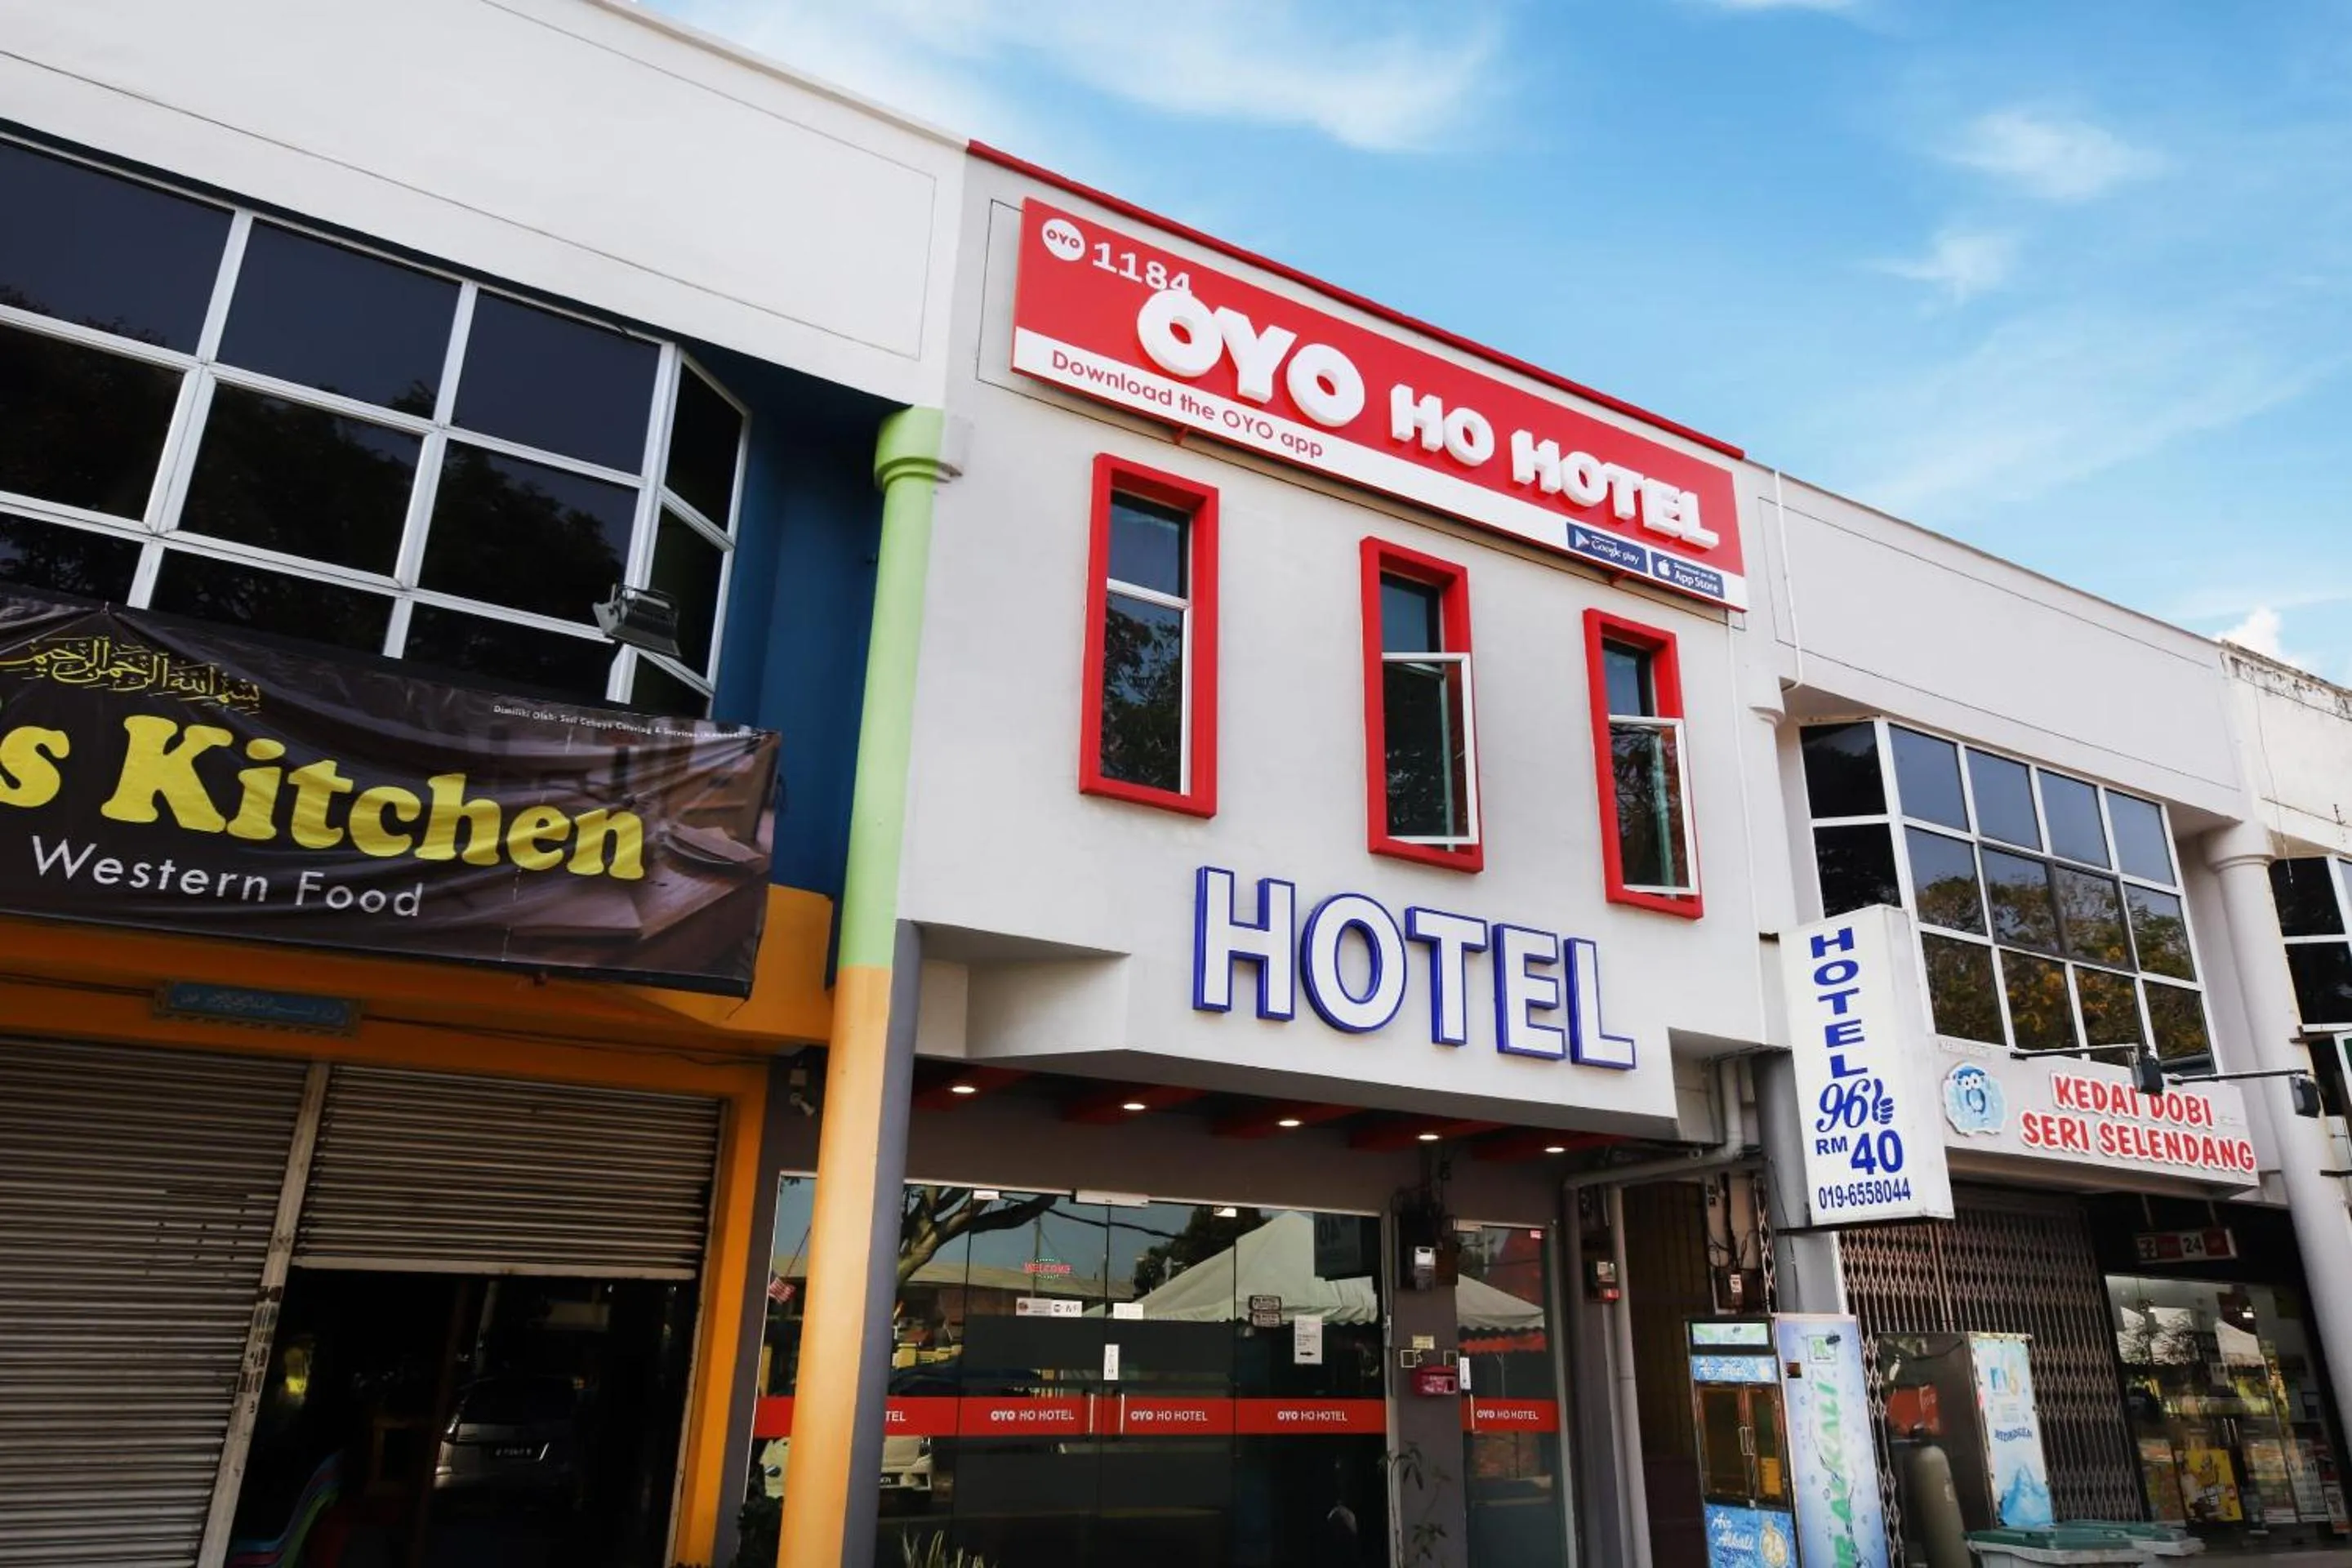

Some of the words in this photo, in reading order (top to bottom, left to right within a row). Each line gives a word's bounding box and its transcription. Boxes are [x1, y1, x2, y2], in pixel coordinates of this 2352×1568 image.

[1046, 228, 1080, 249] OYO
[1093, 243, 1192, 296] 1184
[1052, 350, 1173, 407] Download
[1180, 393, 1215, 421] the
[1223, 409, 1273, 440] OYO
[1281, 430, 1324, 459] app
[1137, 289, 1365, 428] OYO
[1390, 384, 1495, 467] HO
[1511, 430, 1720, 550] HOTEL
[1674, 570, 1695, 587] App
[1695, 577, 1720, 594] Store
[100, 715, 644, 880] Kitchen
[31, 835, 268, 902] Western
[295, 871, 424, 918] Food
[1192, 865, 1637, 1071] HOTEL
[1810, 927, 1869, 1080] HOTEL
[2052, 1075, 2140, 1118] KEDAI
[2149, 1092, 2214, 1128] DOBI
[1816, 1137, 1848, 1156] RM
[1851, 1129, 1904, 1175] 40
[2021, 1111, 2091, 1152] SERI
[2098, 1121, 2256, 1173] SELENDANG
[1818, 1178, 1912, 1210] 019-6558044
[886, 1411, 906, 1422] TEL
[990, 1410, 1016, 1422] OYO
[1018, 1410, 1036, 1422] HO
[1039, 1409, 1075, 1421] HOTEL
[1130, 1410, 1154, 1421] OYO
[1156, 1410, 1172, 1421] HO
[1174, 1410, 1209, 1422] HOTEL
[1277, 1410, 1298, 1420] OYO
[1301, 1410, 1315, 1421] HO
[1316, 1410, 1348, 1422] HOTEL
[1477, 1410, 1495, 1419] OYO
[1511, 1410, 1539, 1421] HOTEL
